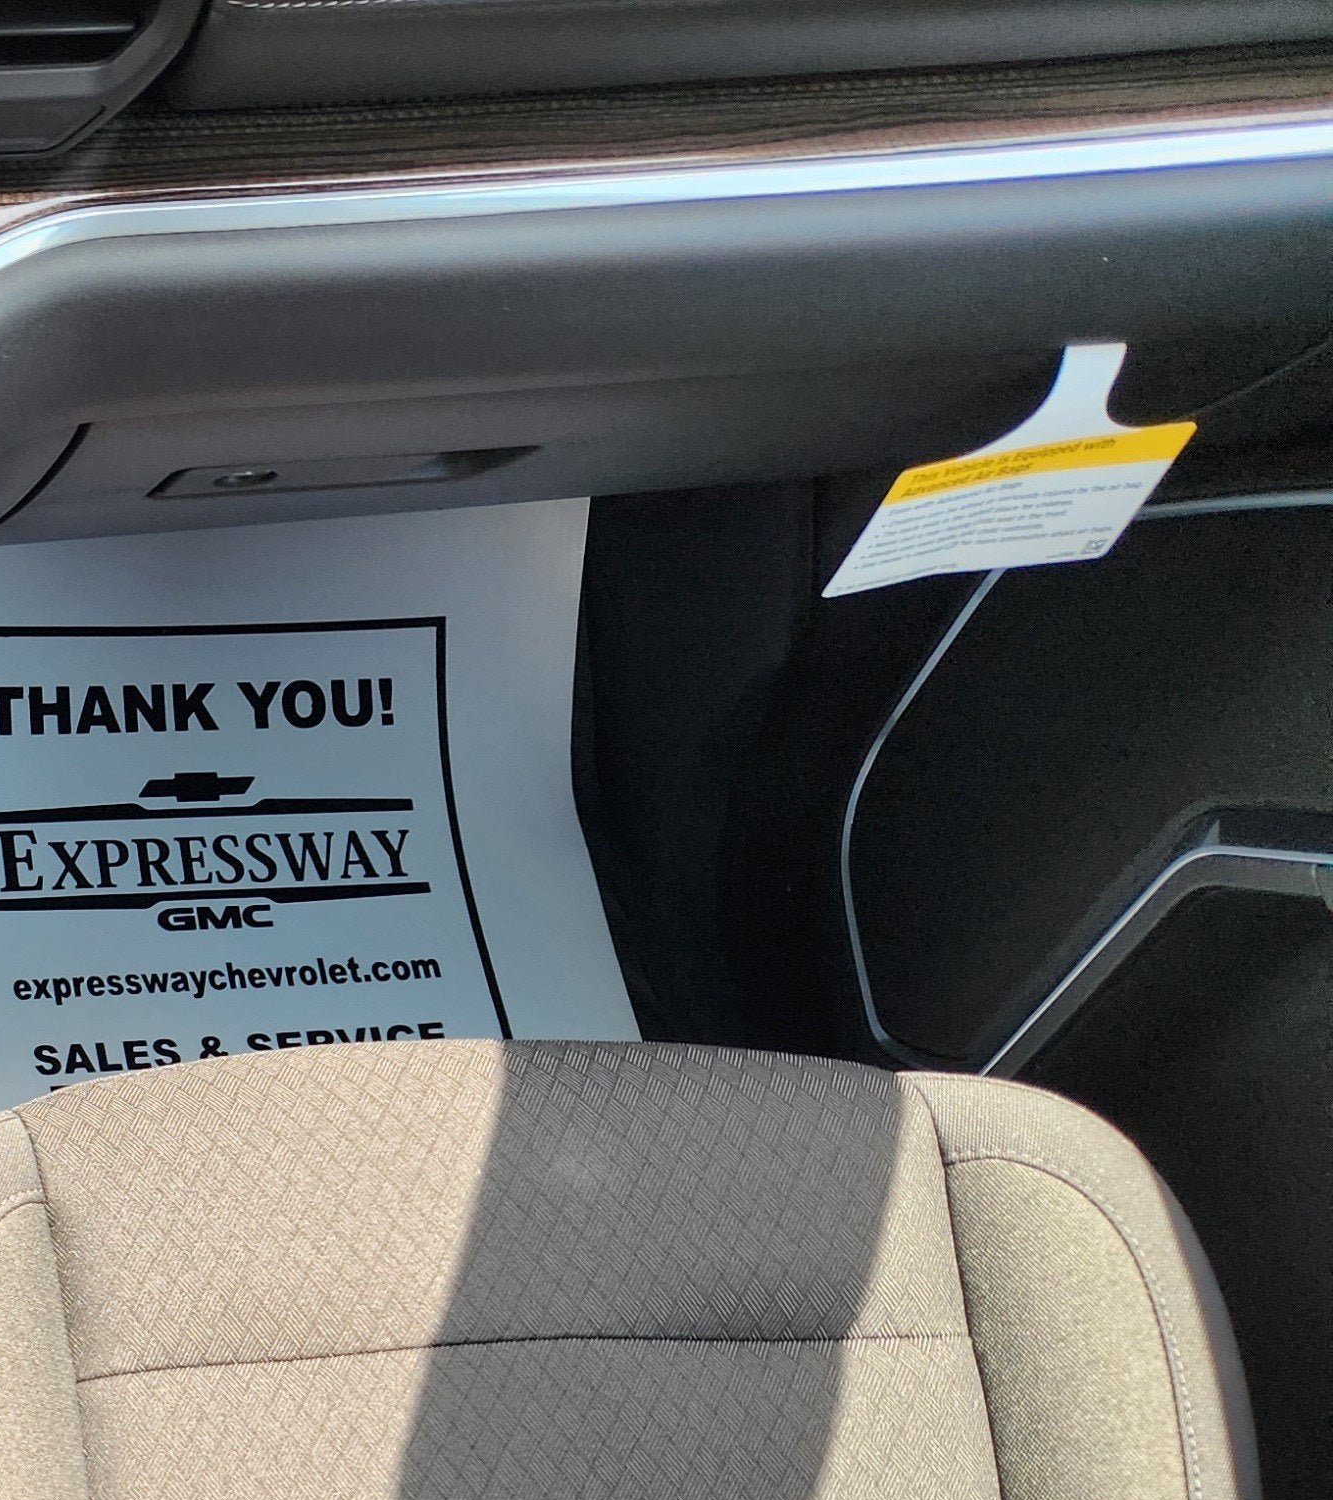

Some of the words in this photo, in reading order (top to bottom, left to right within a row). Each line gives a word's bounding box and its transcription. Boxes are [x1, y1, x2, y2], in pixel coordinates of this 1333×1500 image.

[911, 471, 940, 482] This
[944, 460, 993, 474] Vehicle
[1014, 444, 1081, 461] Equipped
[1083, 438, 1116, 450] with
[236, 678, 395, 730] YOU!
[156, 904, 275, 932] GMC
[12, 957, 442, 1005] expresswaychevrolet.com
[33, 1038, 183, 1077] SALES
[198, 1036, 229, 1060] &
